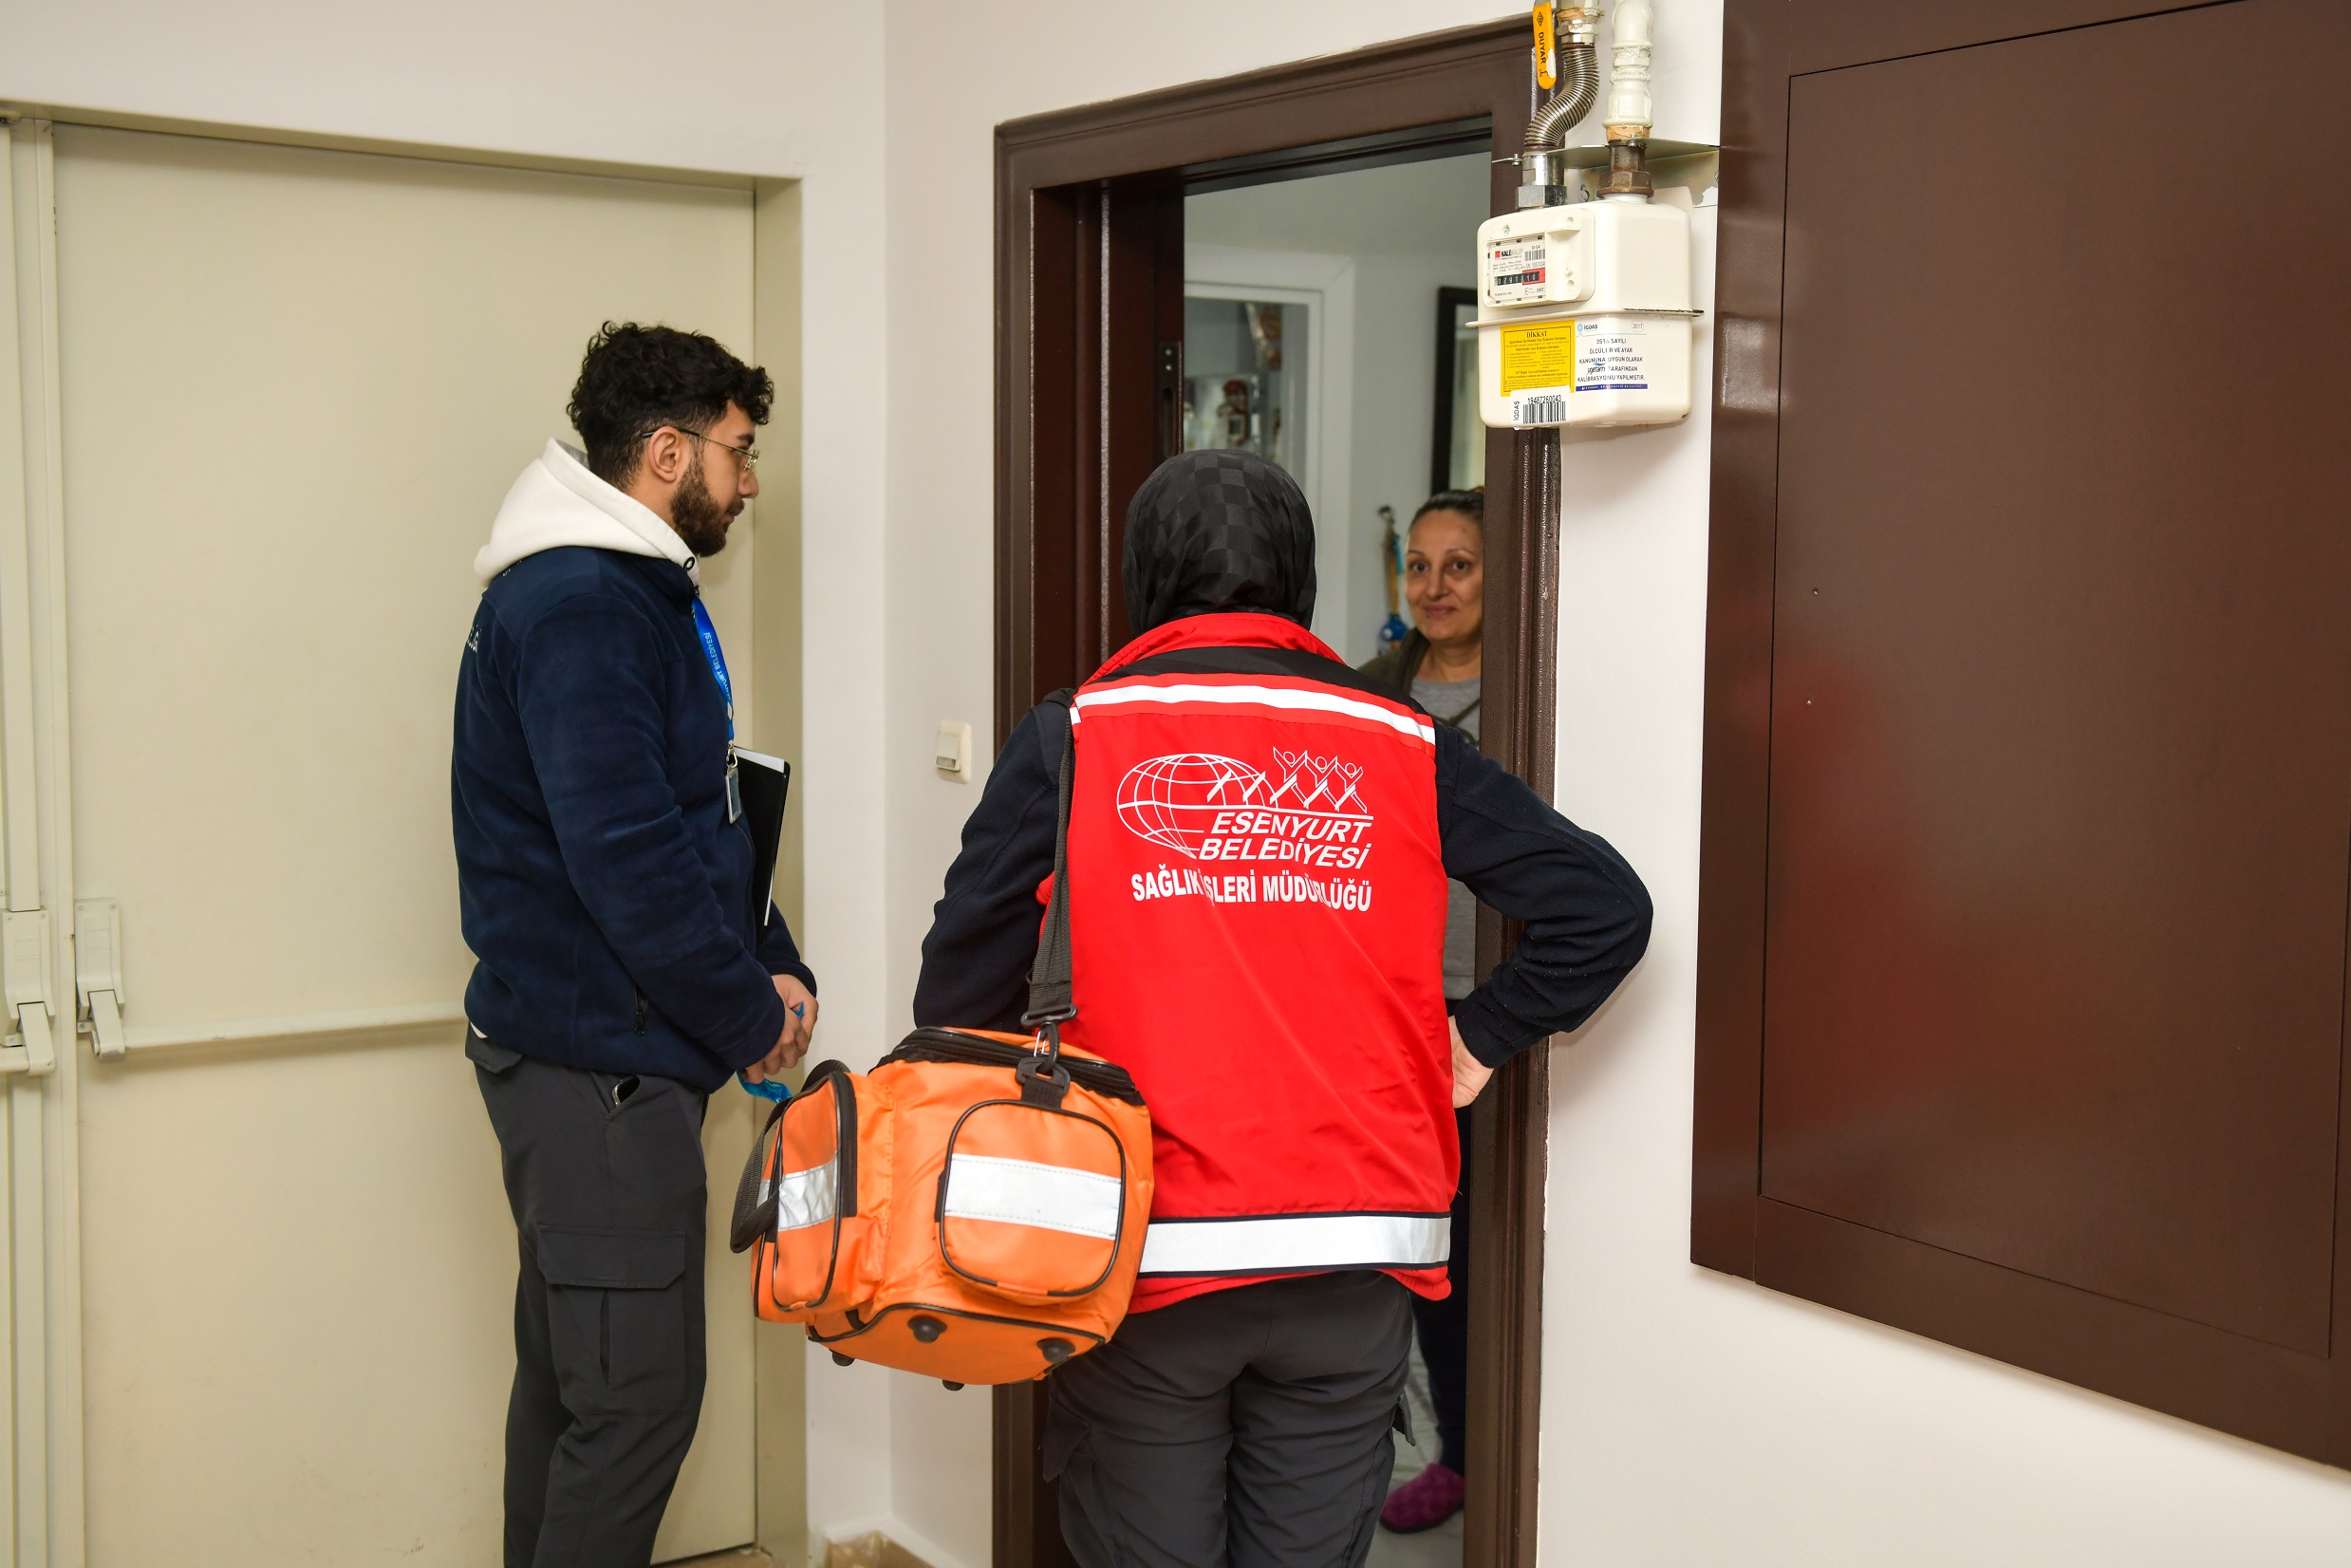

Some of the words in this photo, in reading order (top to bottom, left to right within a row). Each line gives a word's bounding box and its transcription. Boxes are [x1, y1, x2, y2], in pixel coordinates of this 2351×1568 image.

[703, 632, 720, 670] BELEDİYESİ
[1210, 811, 1372, 844] ESENYURT
[1198, 836, 1372, 869] BELEDİYESİ
[1130, 862, 1204, 902] SAĞLIK
[1261, 868, 1373, 912] MÜDÜRLÜĞÜ
